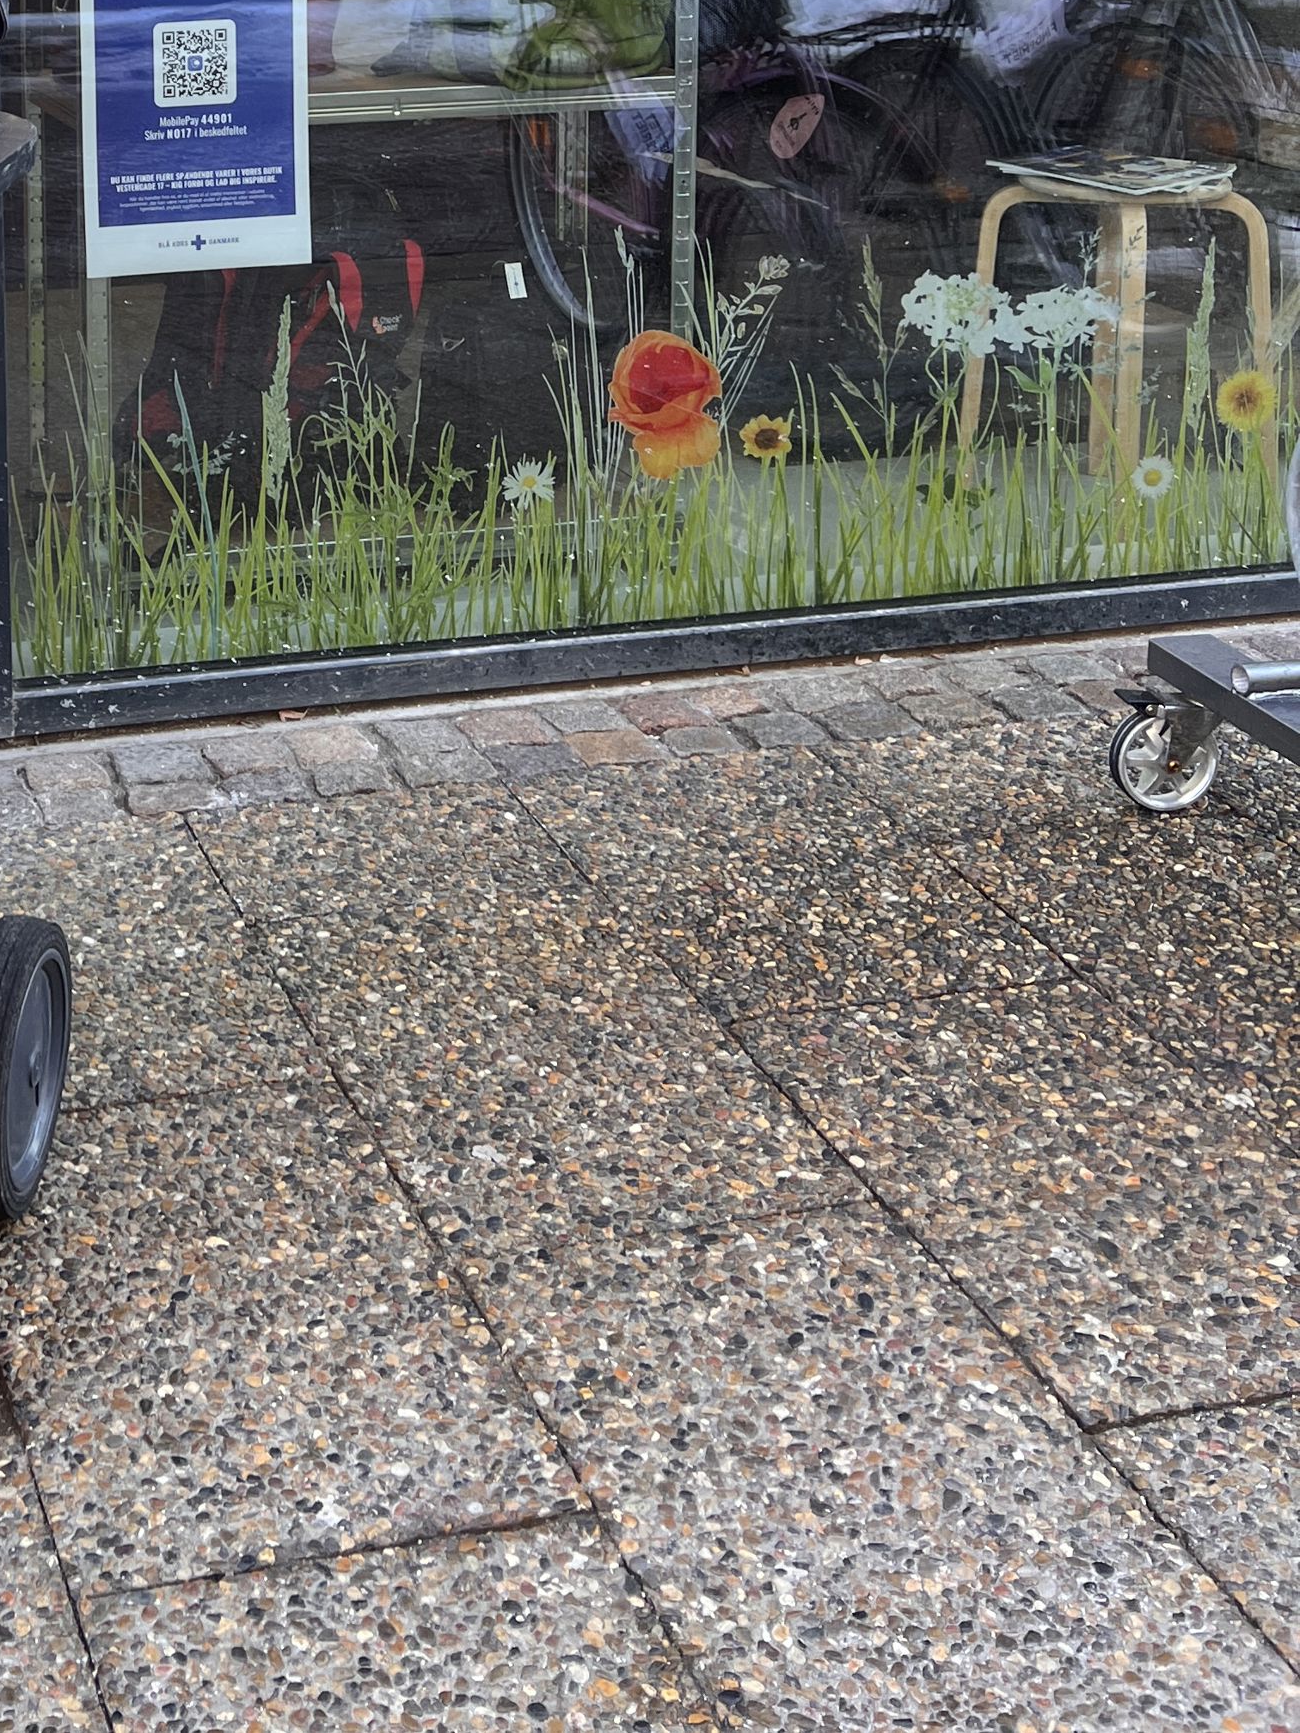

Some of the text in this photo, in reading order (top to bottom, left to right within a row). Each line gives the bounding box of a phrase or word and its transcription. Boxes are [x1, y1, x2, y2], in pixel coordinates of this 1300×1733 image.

[159, 113, 232, 127] MobilePay 44901
[144, 129, 165, 141] Skriv
[199, 125, 248, 138] beskedfeltet
[110, 176, 120, 185] DU
[121, 175, 135, 184] KAN
[136, 173, 155, 183] FINDE
[155, 172, 175, 182] FLERE
[175, 170, 214, 181] SPÆNDENDE
[214, 168, 236, 178] VARER
[240, 167, 262, 176] VORES
[262, 166, 283, 175] BUTIK
[115, 182, 156, 193] VESTERGADE
[157, 181, 165, 190] 17
[171, 181, 183, 189] KIG
[204, 178, 214, 187] OG
[215, 177, 229, 187] LAD
[229, 176, 241, 186] DIG
[158, 239, 170, 249] BLÅ
[208, 237, 240, 245] DANMARK
